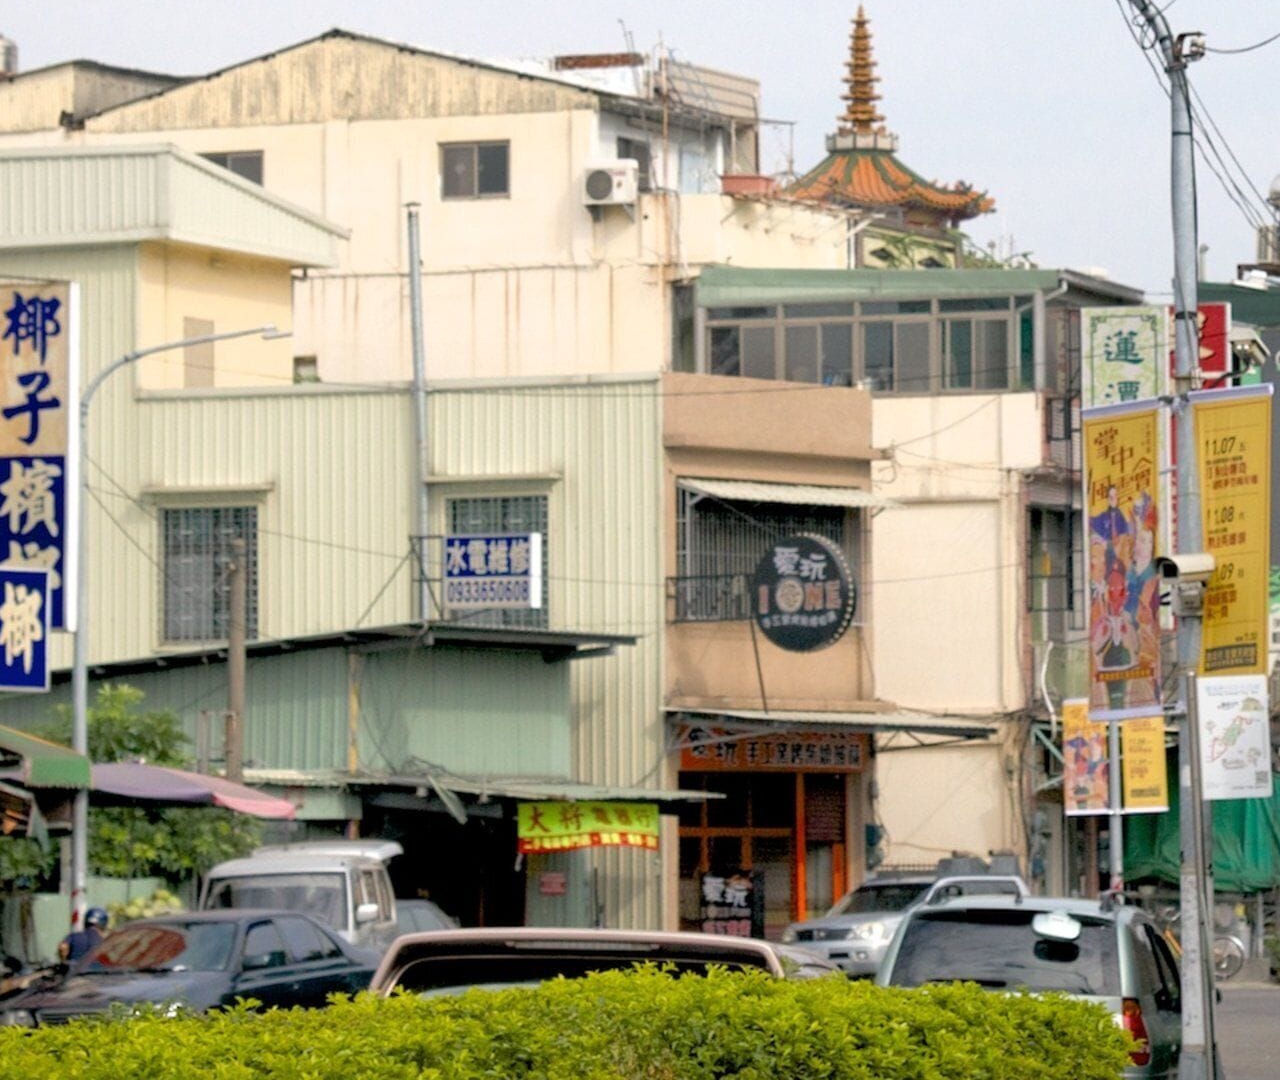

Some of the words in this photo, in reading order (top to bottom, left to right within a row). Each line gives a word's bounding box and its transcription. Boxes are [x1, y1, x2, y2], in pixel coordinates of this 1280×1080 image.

[446, 539, 529, 576] 水電維修
[772, 547, 827, 581] 愛玩
